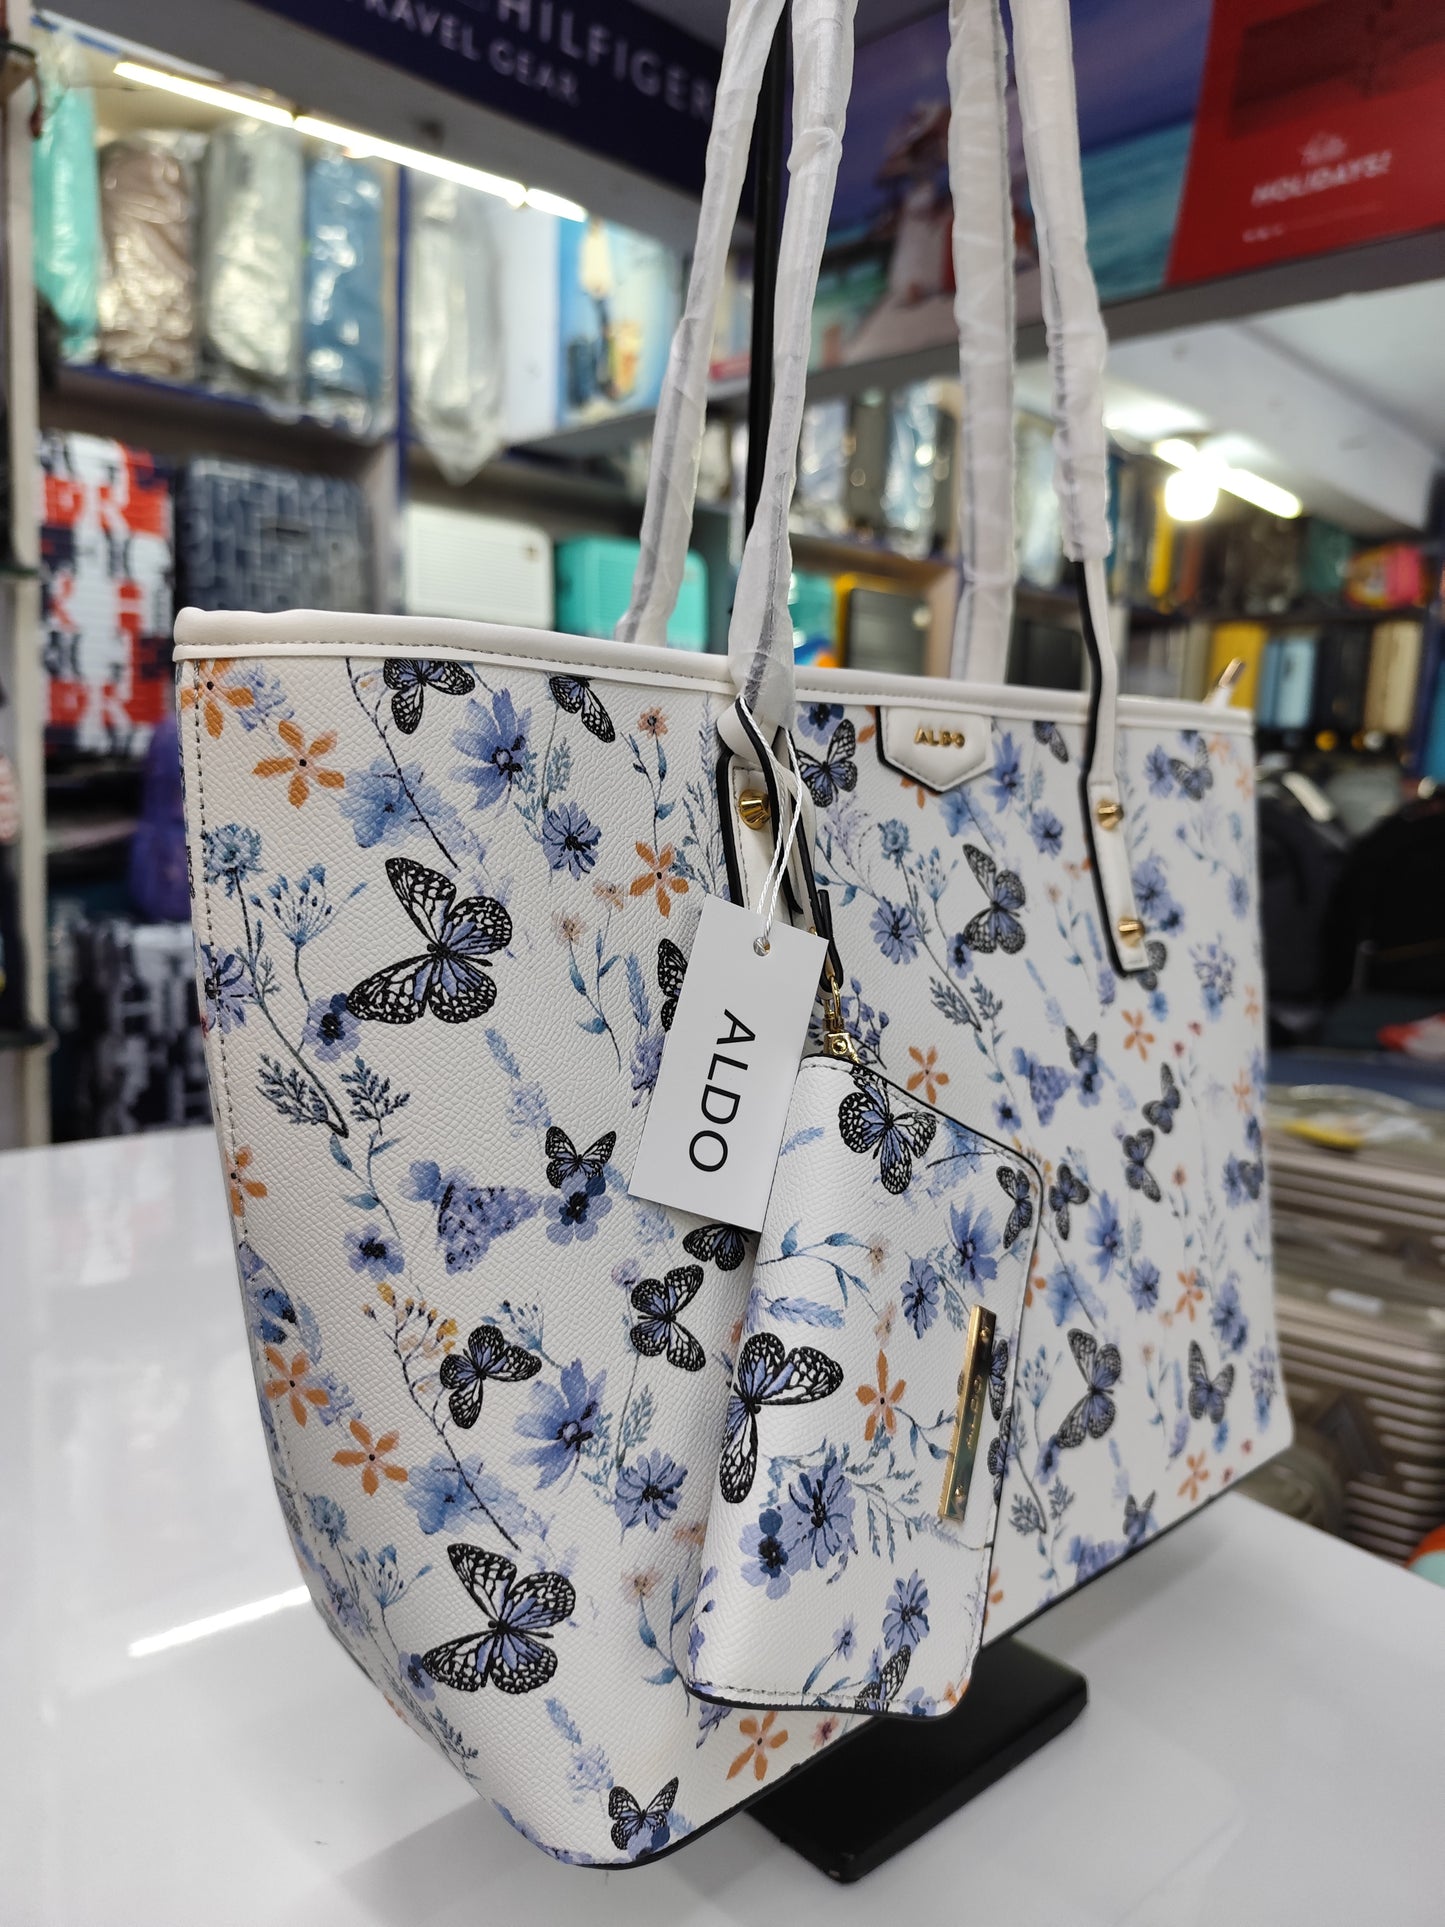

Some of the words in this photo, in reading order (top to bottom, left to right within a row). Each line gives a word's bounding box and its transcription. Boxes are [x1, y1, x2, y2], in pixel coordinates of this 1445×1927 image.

[488, 38, 580, 108] GEAR
[914, 728, 965, 748] ALDO
[689, 1008, 756, 1172] ALDO
